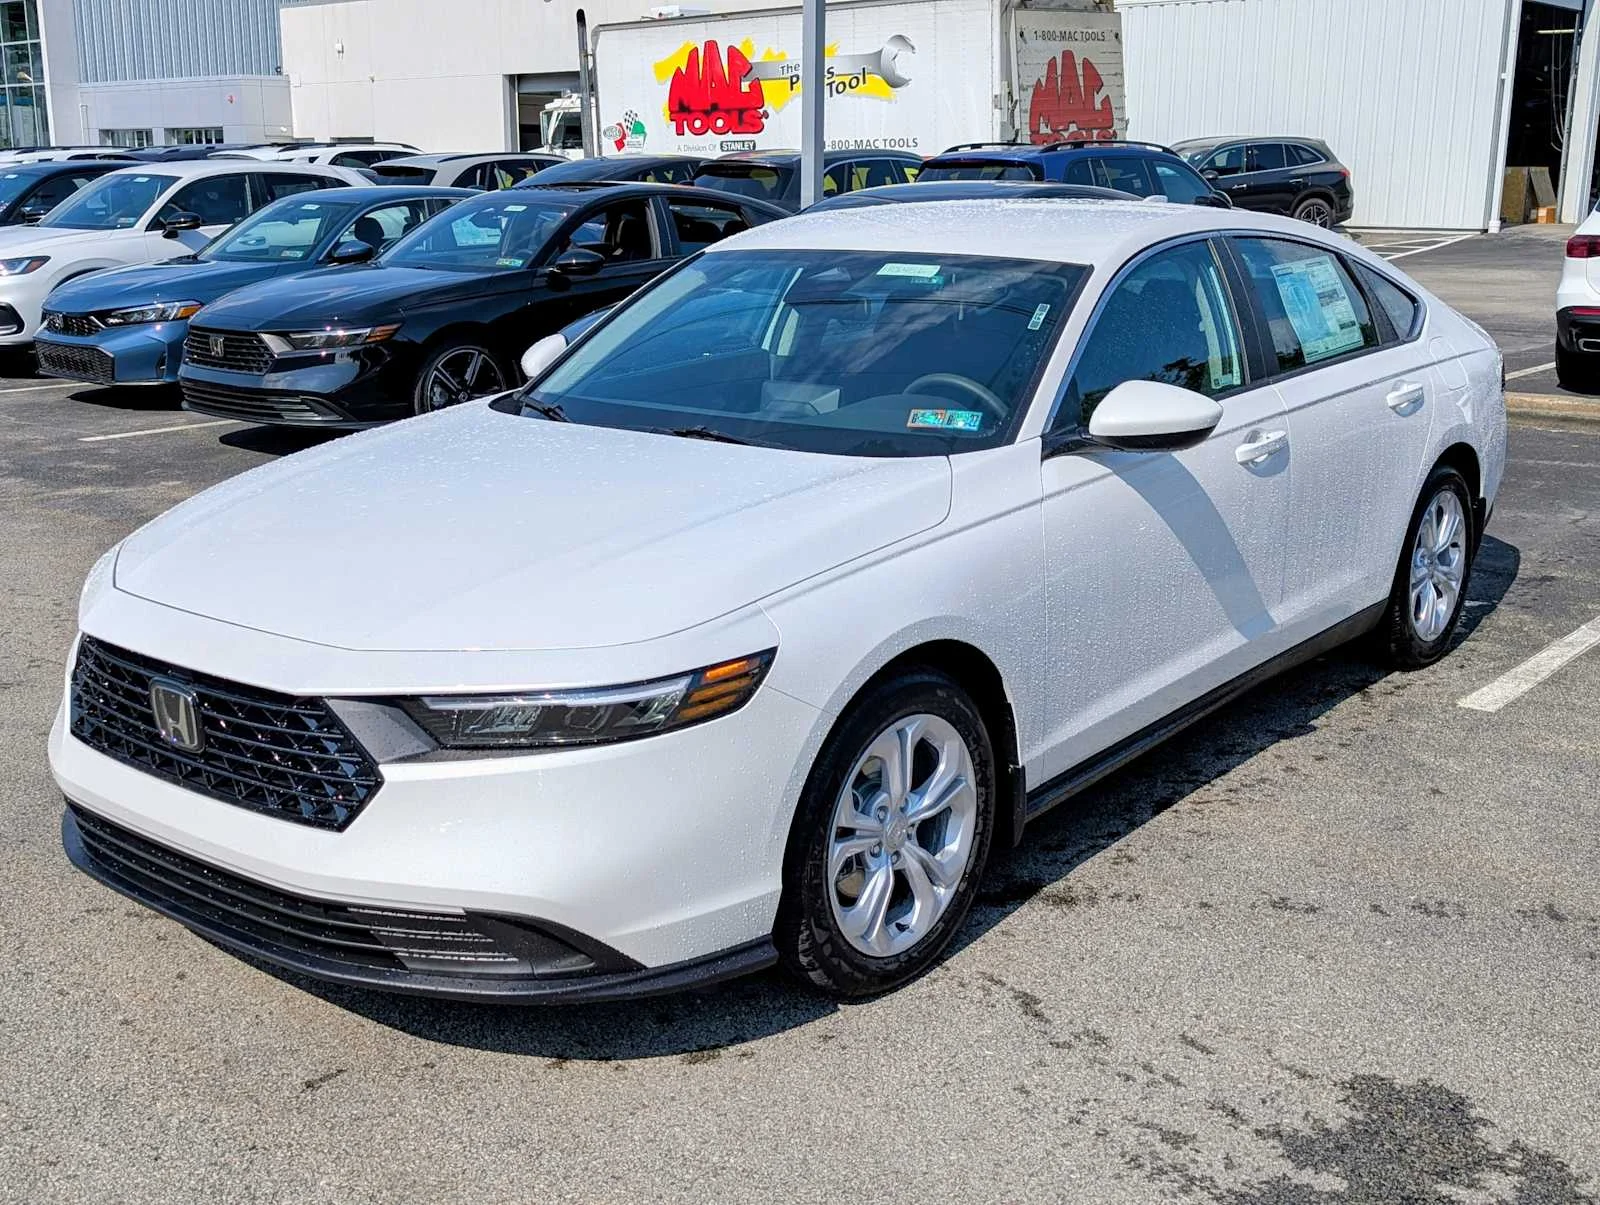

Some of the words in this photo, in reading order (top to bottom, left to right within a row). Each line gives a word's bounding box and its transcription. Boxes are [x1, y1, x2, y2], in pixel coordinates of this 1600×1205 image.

[1033, 30, 1078, 41] 1-800-MAC
[1080, 31, 1106, 42] TOOLS
[668, 39, 765, 112] MAC
[780, 63, 801, 75] The
[826, 67, 867, 98] Tool
[1029, 49, 1114, 129] MAC
[669, 110, 765, 136] TOOLS
[722, 141, 754, 151] STANLEY
[882, 138, 918, 148] TOOLS
